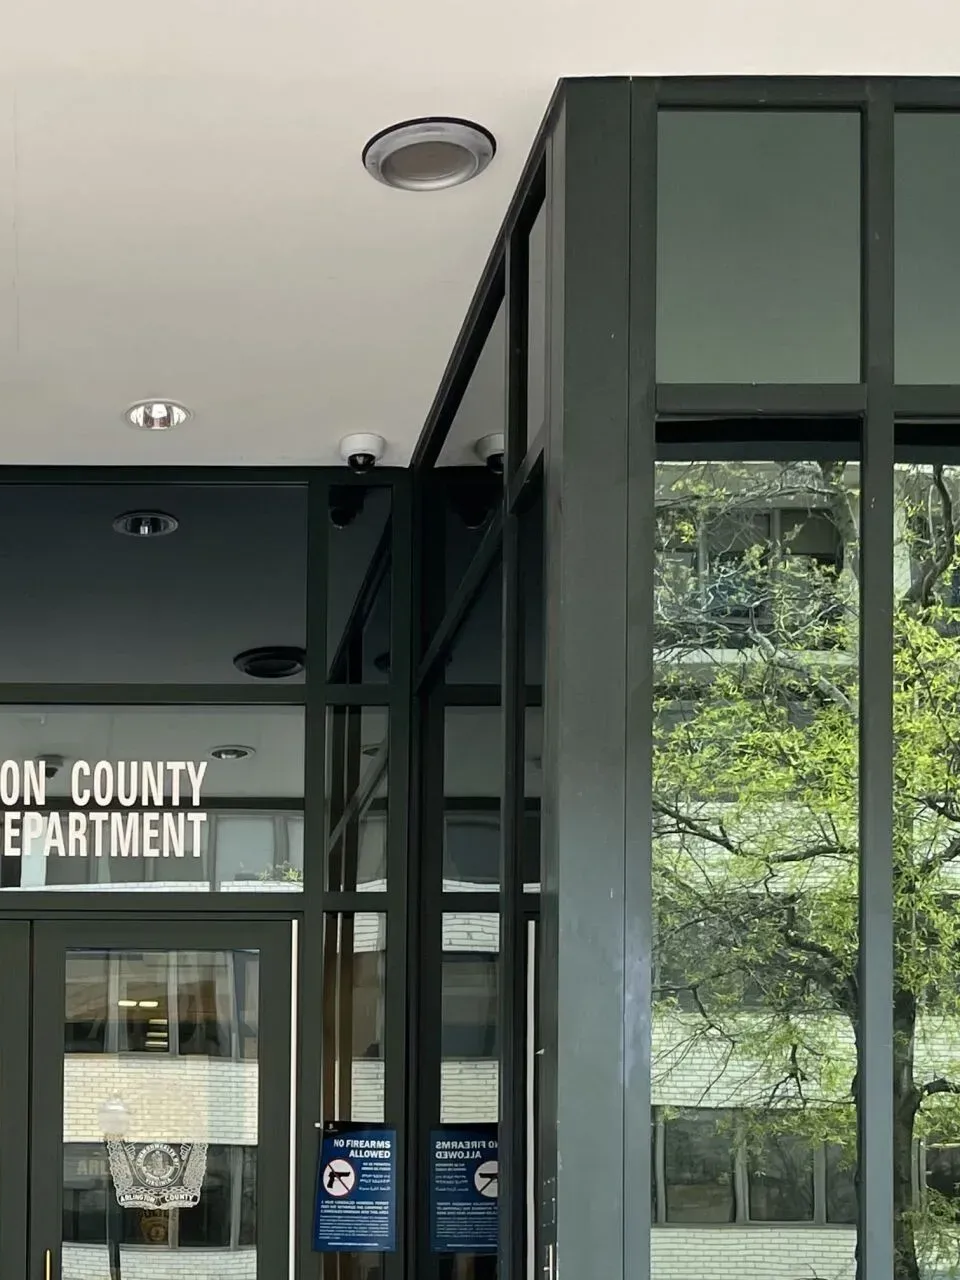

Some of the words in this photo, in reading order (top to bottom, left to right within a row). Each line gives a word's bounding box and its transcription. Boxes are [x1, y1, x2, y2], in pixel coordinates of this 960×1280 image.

[71, 760, 208, 807] COUNTY
[333, 1139, 344, 1148] NO
[346, 1139, 391, 1149] FIREARMS
[349, 1149, 391, 1159] ALLOWED
[120, 1194, 156, 1203] ARLINGTON
[165, 1194, 193, 1202] COUNTY
